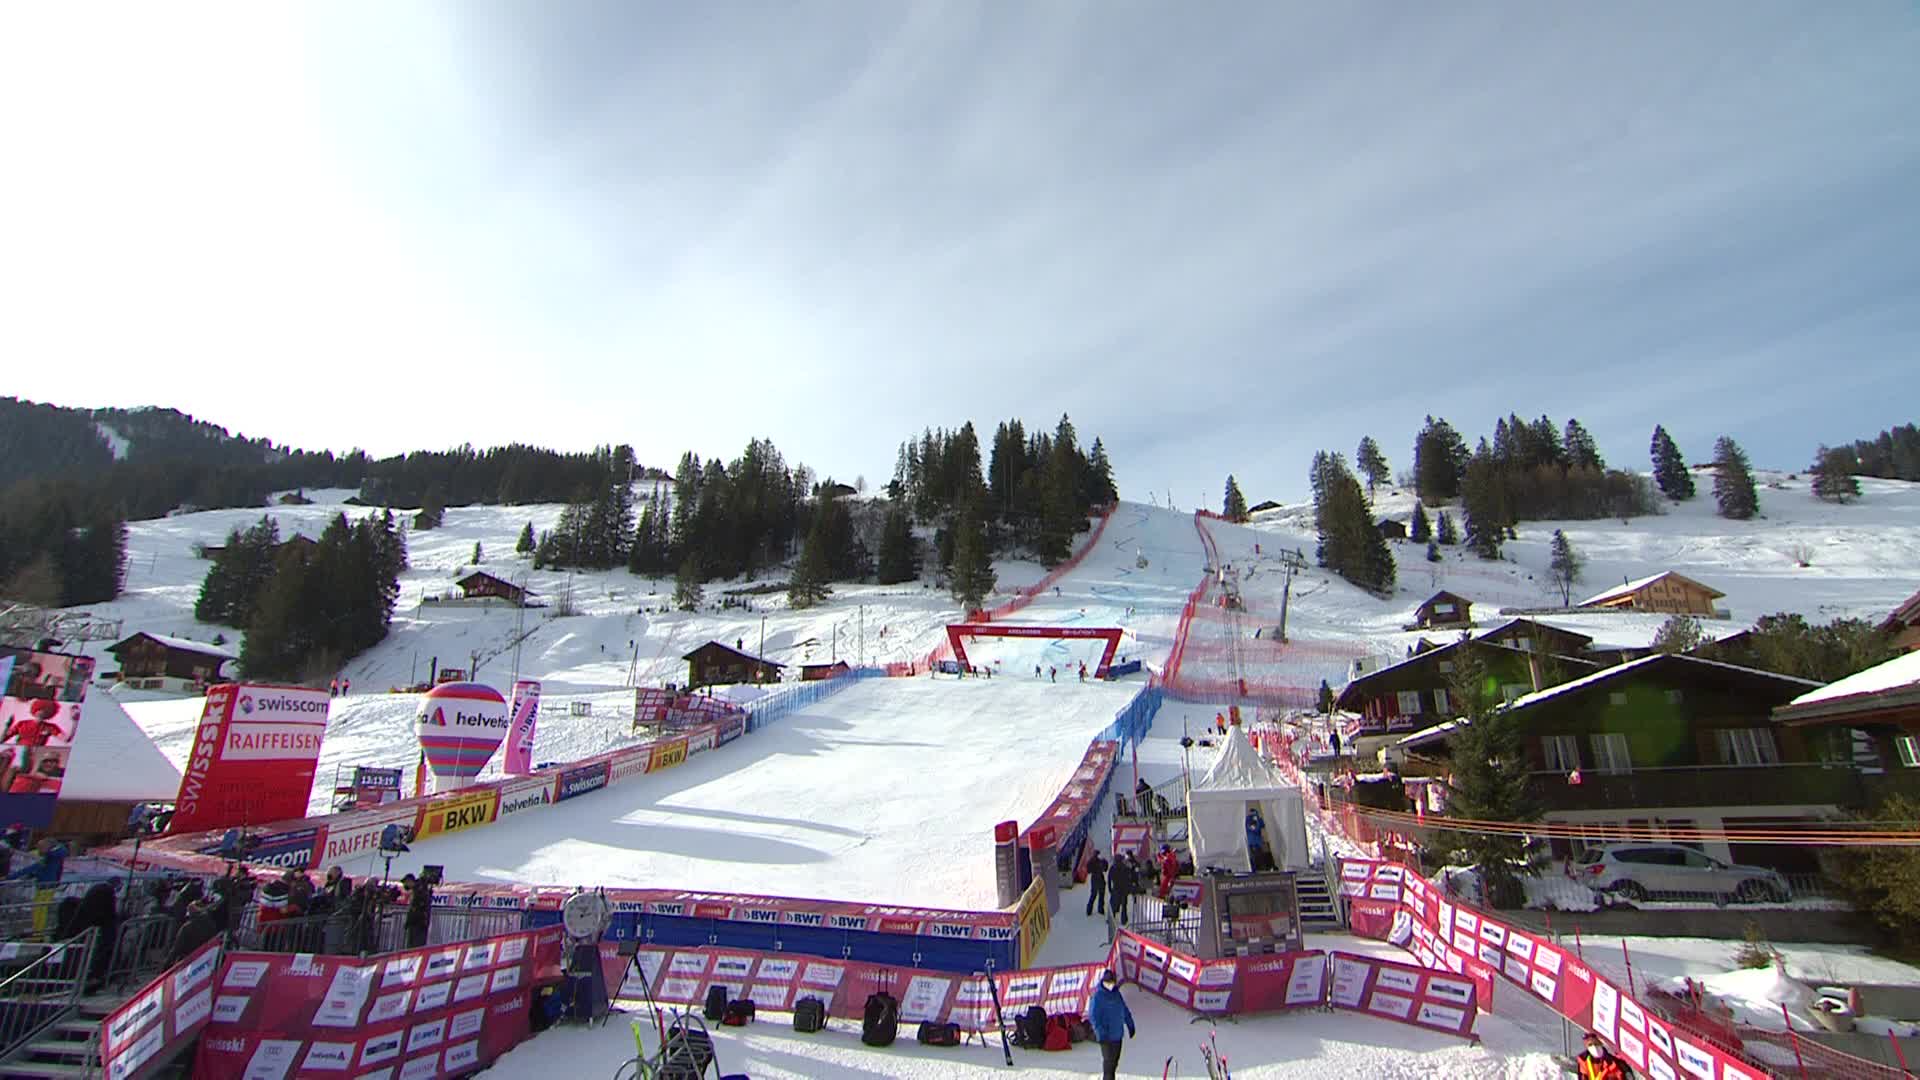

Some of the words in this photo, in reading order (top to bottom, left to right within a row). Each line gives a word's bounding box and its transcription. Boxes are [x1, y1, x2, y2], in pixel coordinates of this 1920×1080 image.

[258, 695, 329, 714] swisscom
[230, 732, 322, 749] RAIFFEISEN
[662, 749, 682, 767] BKW
[568, 773, 606, 794] swisscom
[501, 795, 540, 815] helvetia
[445, 804, 487, 830] BKW
[328, 831, 380, 859] RAIFFE
[496, 897, 518, 907] BWT
[620, 902, 642, 912] BWT
[659, 904, 682, 914] BWT
[751, 910, 777, 921] BWT
[794, 913, 821, 925] BWT
[839, 916, 866, 928] BWT
[941, 925, 969, 937] BWT
[990, 928, 1011, 939] BW
